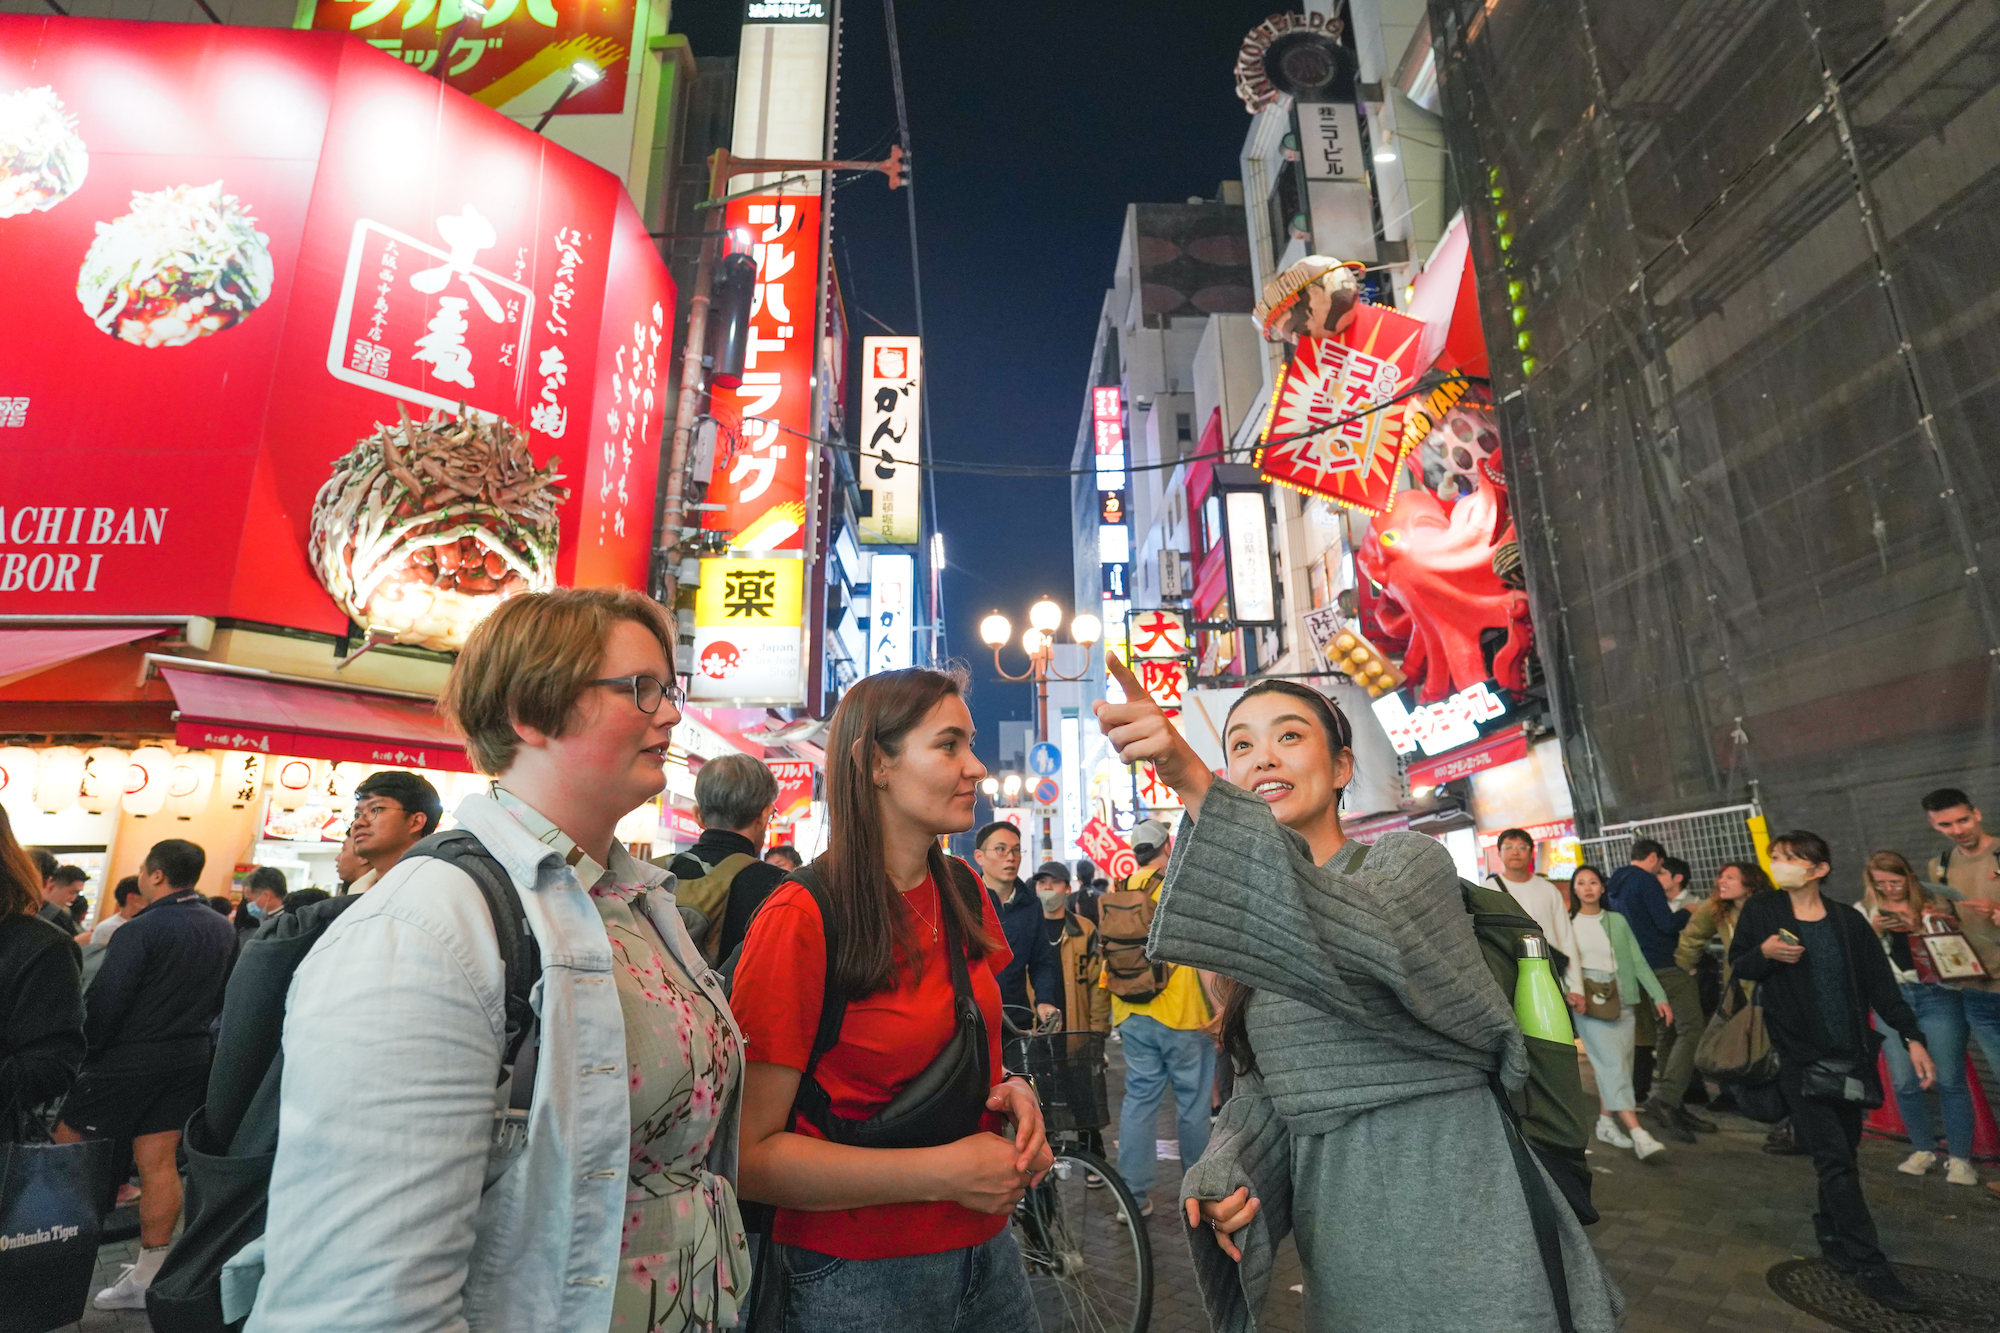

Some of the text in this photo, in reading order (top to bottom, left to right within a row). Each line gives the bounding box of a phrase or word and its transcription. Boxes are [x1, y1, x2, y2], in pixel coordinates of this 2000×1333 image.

[366, 37, 503, 76] ラッグ
[729, 205, 796, 503] ツルハドラッグ
[870, 379, 917, 481] がんこ
[0, 506, 169, 545] CHIBAN
[881, 491, 894, 536] 道頓堀店
[0, 553, 103, 592] BORI
[724, 570, 776, 618] 薬
[754, 655, 797, 666] Tax-free
[759, 643, 797, 654] Japan.
[769, 666, 797, 679] Shop
[682, 723, 701, 751] くすり
[238, 755, 257, 801] たこ焼
[769, 763, 812, 778] ツルハ
[778, 779, 804, 790] ラッグ
[0, 1224, 79, 1251] Onitsuka Tiger
